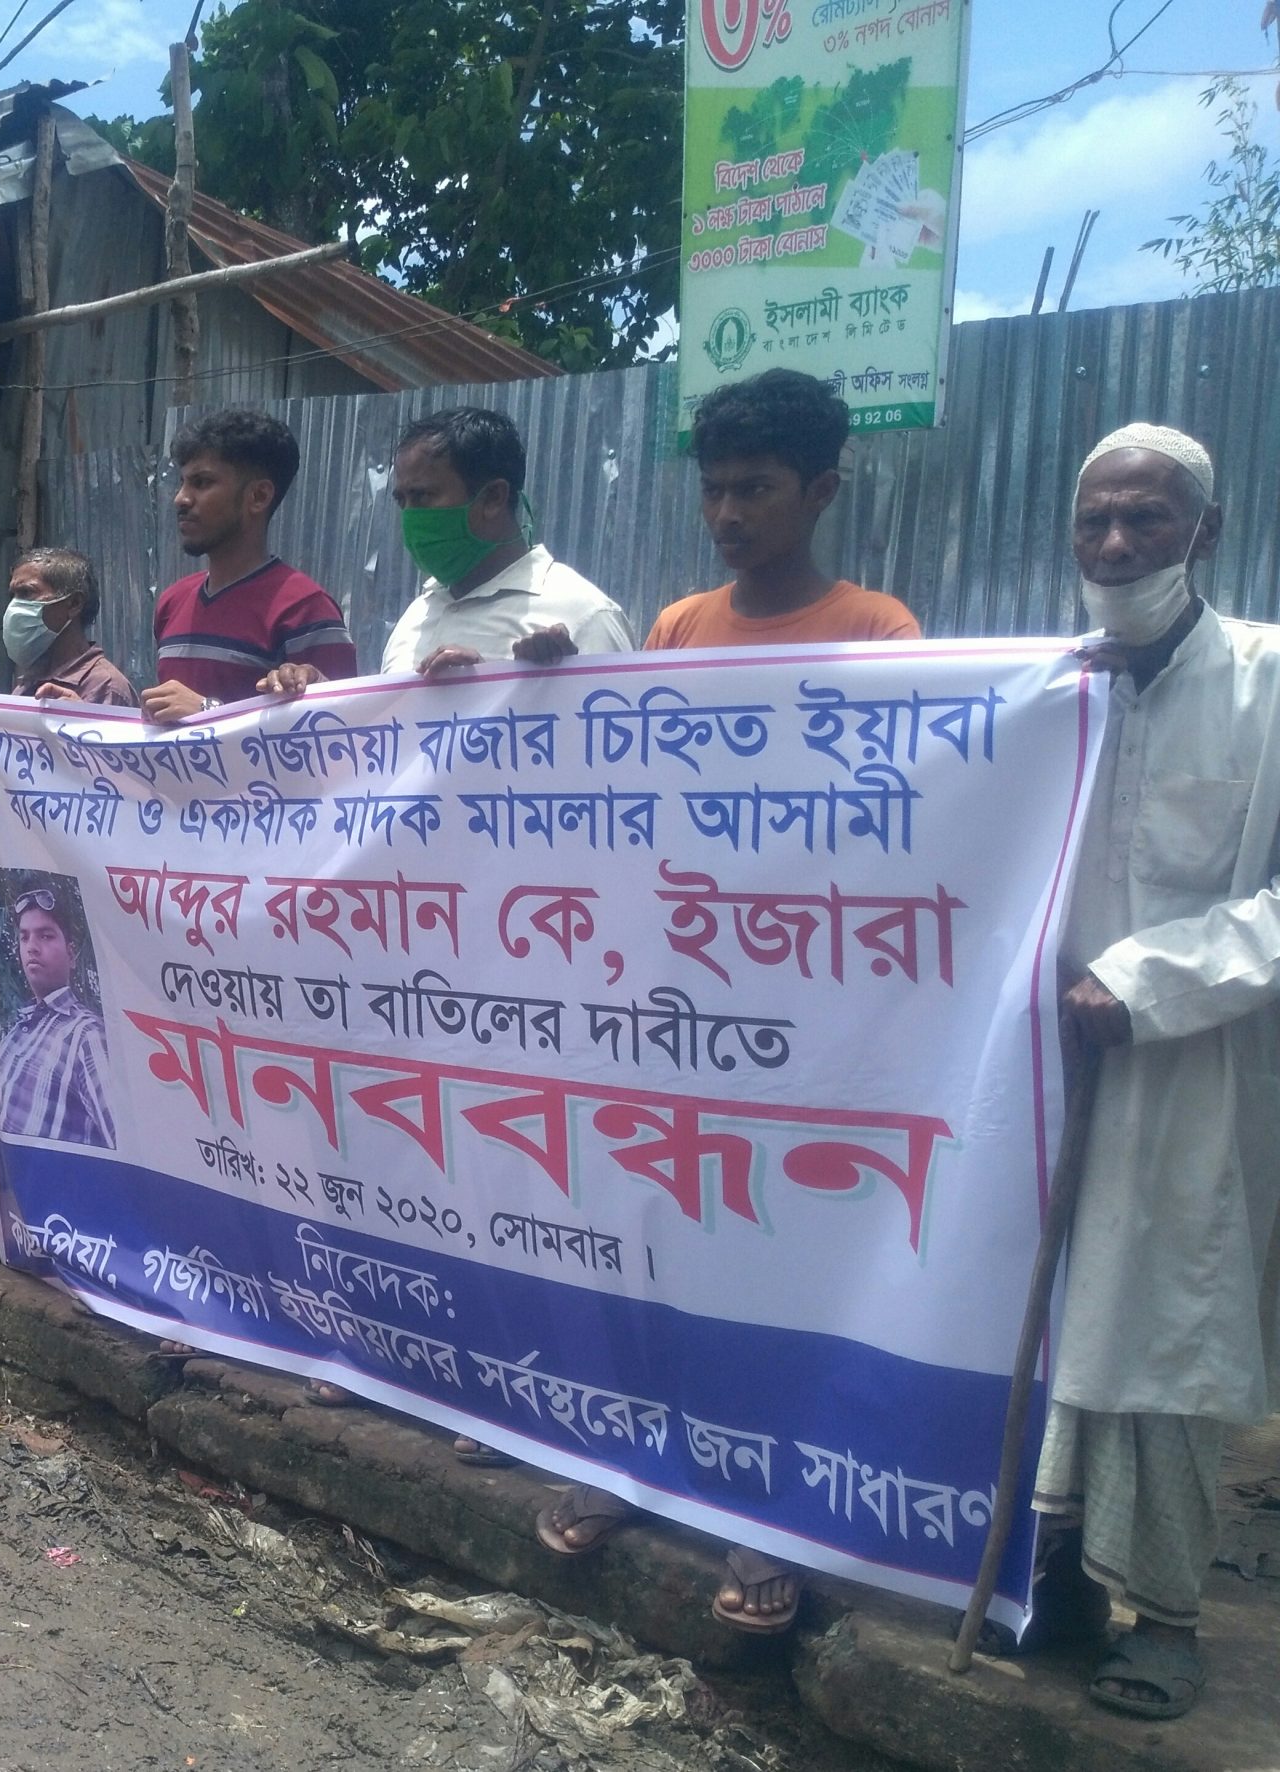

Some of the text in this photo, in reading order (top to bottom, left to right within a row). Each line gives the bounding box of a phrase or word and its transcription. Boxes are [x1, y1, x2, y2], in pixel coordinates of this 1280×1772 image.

[824, 30, 849, 52] ৩%
[855, 17, 892, 45] নগদ
[897, 0, 952, 34] বোনাস
[692, 183, 827, 235] ১ লক্ষ টাকা পাঠালে
[714, 148, 805, 193] বিদেশ থেকে
[688, 223, 828, 272] ৩০০০ টাকা বোনাস
[765, 284, 911, 333] ইসলামী ব্যাংক
[848, 409, 902, 427] 9 92 06
[851, 366, 893, 393] অফিস
[241, 710, 404, 779] গর্জনিয়া
[416, 707, 558, 773] বাজার
[575, 686, 776, 774] চিহ্নিত
[794, 679, 1007, 772] ইয়াবা
[5, 765, 923, 854] ব্যবসায়ী ও একাধীক মাদক মামলার আসামী
[105, 861, 250, 956] আব্দুর
[265, 870, 468, 958] রহমান
[655, 859, 970, 987] ইজারা
[160, 961, 796, 1071] দেওয়ায় তা বাতিলের দাবীতে
[122, 1009, 957, 1260] মানববন্ধন
[276, 1161, 316, 1206] ২২
[318, 1172, 365, 1220] জুন
[377, 1185, 476, 1249] ২০২০,
[490, 1211, 622, 1275] সোমবার
[294, 1222, 456, 1319] নিবেদক:
[142, 1244, 271, 1322] গর্জনিয়া
[267, 1270, 463, 1390] ইউনিয়নের
[680, 1410, 778, 1496] জন
[793, 1440, 998, 1549] সাধারণ
